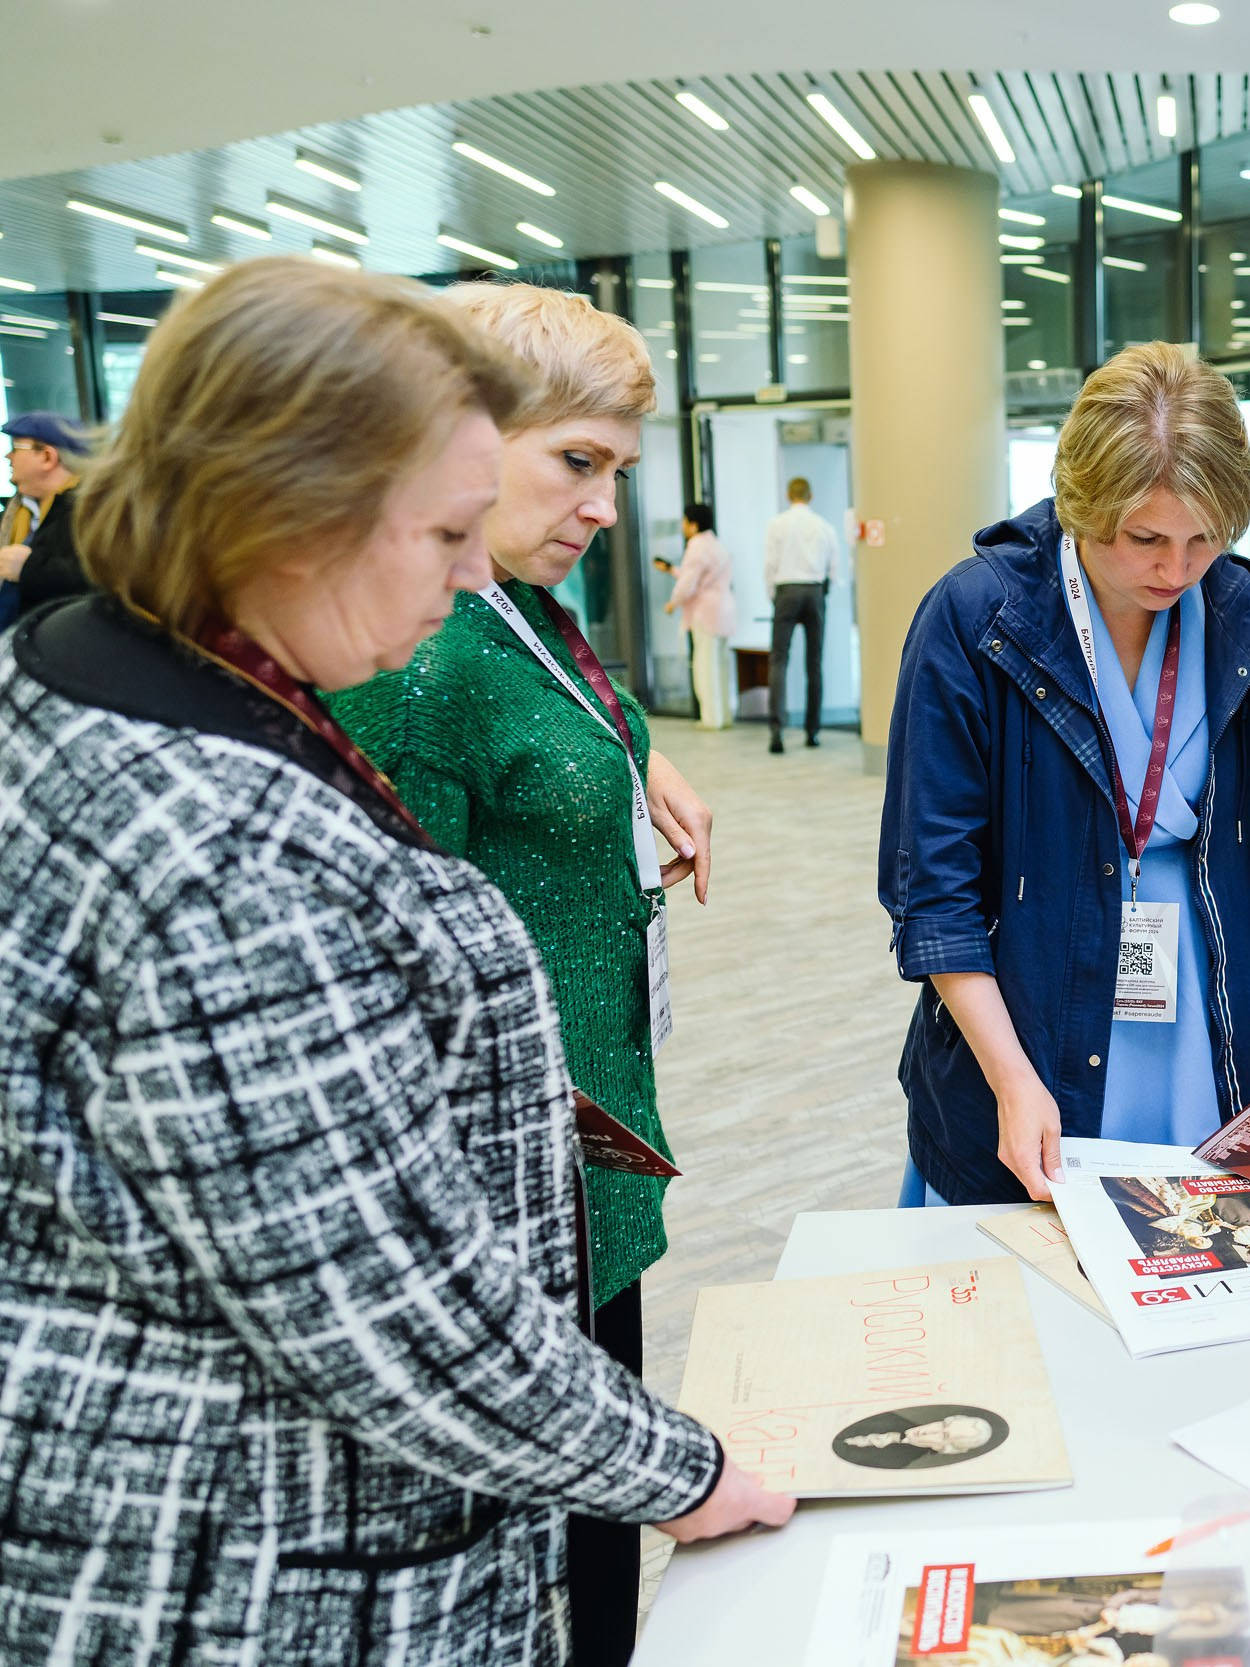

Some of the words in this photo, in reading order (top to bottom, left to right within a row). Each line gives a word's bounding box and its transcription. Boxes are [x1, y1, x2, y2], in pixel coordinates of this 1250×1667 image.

[1069, 578, 1081, 600] 2024
[490, 591, 514, 615] 2024
[1138, 1254, 1208, 1265] УПРАВЛЯТЬ
[1142, 1260, 1212, 1274] ИСКУССТВО
[1140, 1289, 1182, 1305] 39
